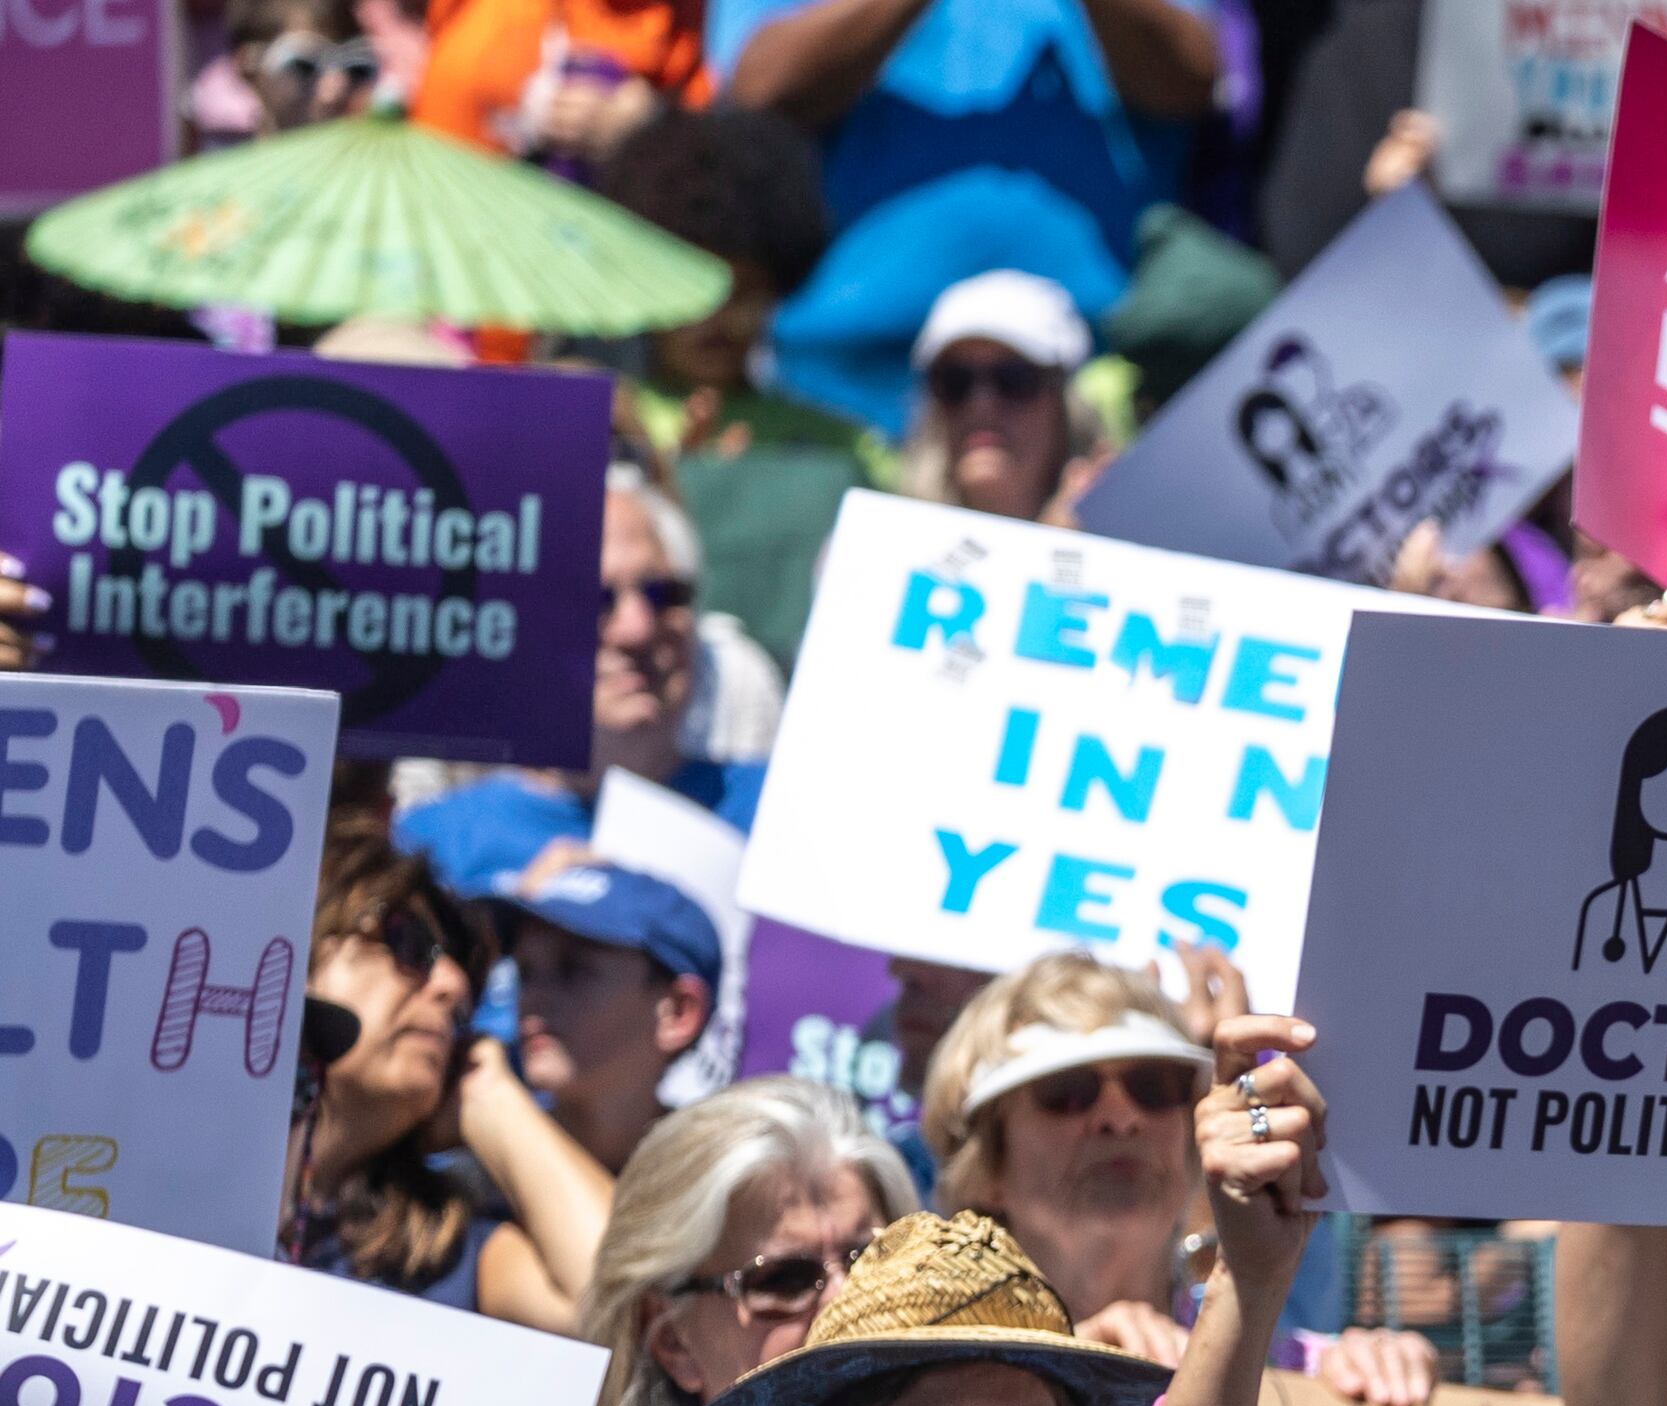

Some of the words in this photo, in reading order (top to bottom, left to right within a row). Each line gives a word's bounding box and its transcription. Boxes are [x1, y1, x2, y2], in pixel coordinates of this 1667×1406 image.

[53, 462, 213, 568] Stop
[240, 475, 542, 575] Political
[67, 553, 517, 660] Interference
[890, 568, 1324, 723] REME
[994, 706, 1164, 823] IN
[933, 827, 1248, 955] YES
[1408, 1085, 1517, 1151] NOT
